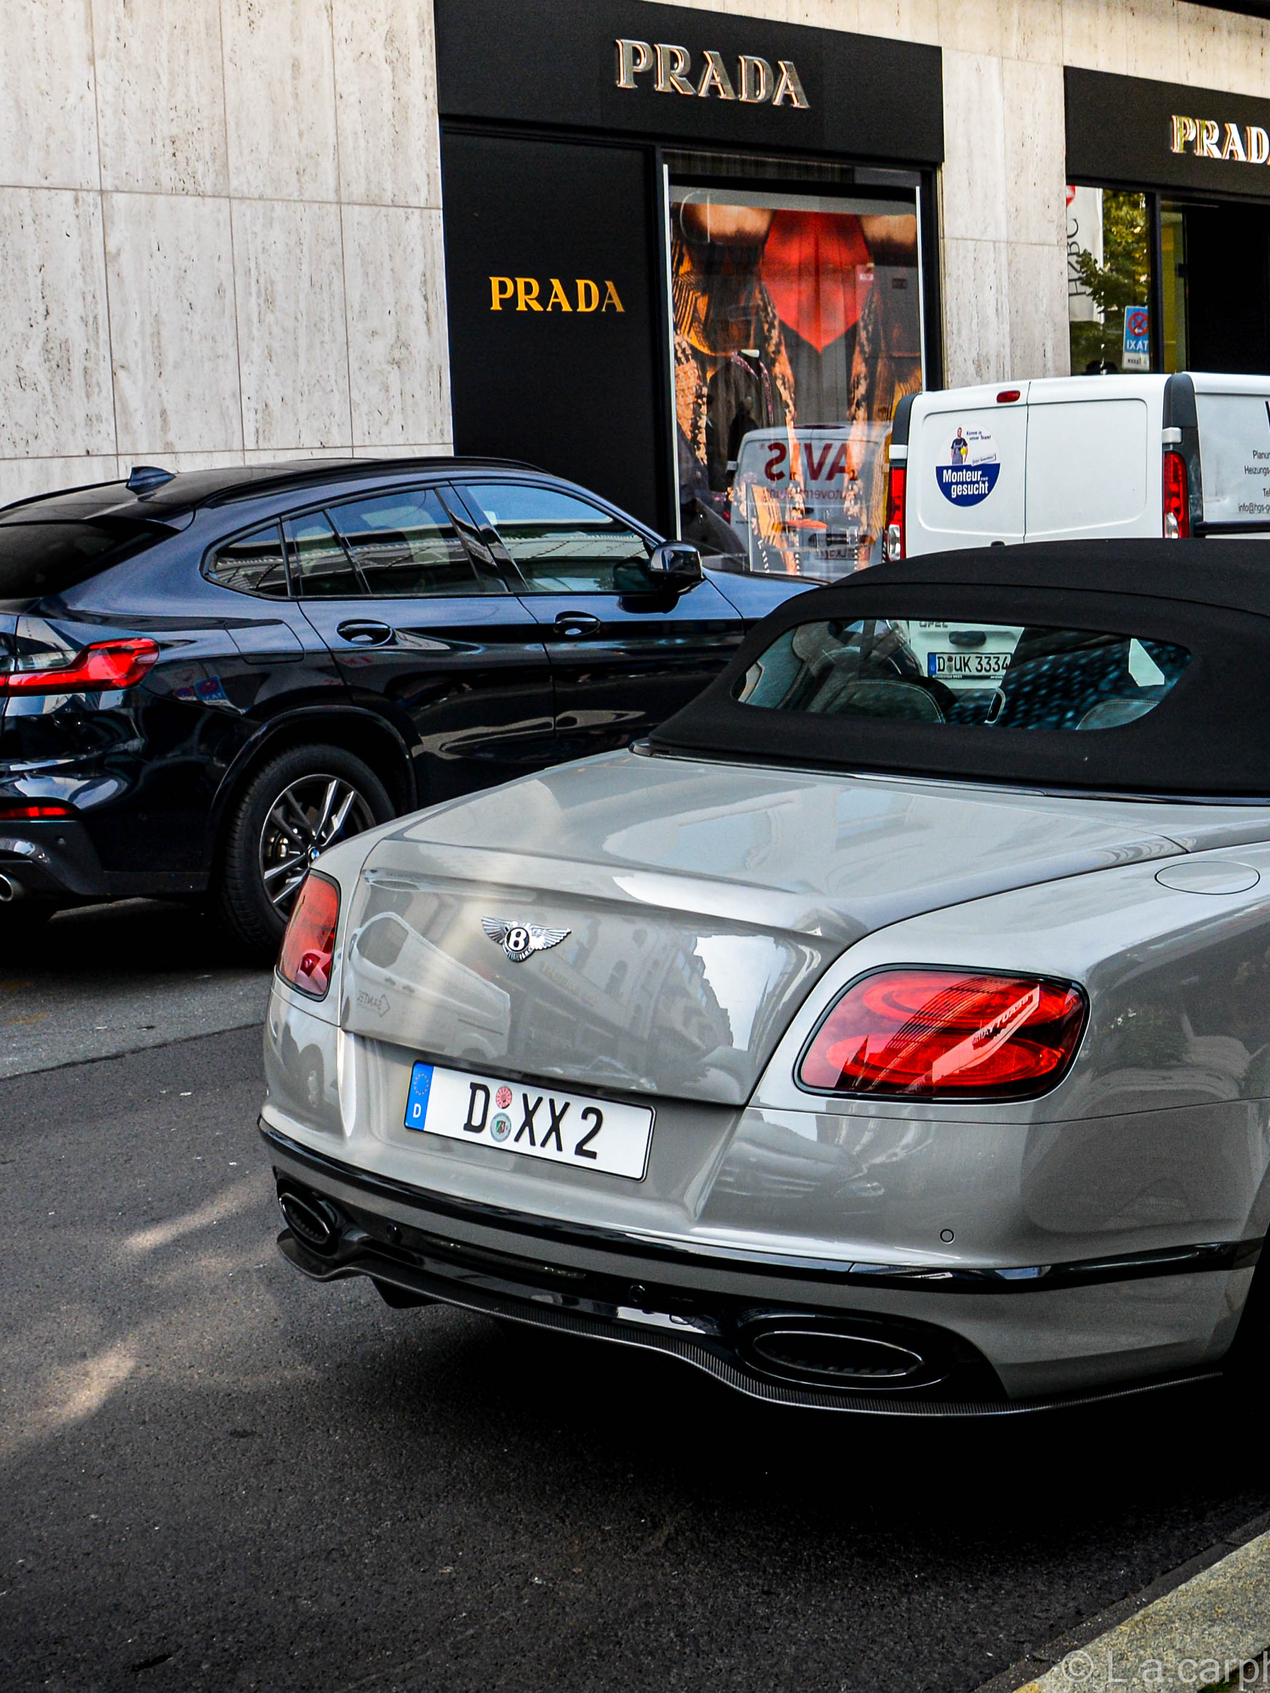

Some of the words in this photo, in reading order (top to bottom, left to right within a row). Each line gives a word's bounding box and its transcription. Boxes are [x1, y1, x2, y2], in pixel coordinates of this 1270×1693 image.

[615, 39, 810, 109] PRADA
[489, 276, 625, 312] PRADA
[943, 469, 982, 482] Monteur
[951, 481, 988, 498] gesucht
[937, 656, 945, 672] D
[954, 656, 972, 672] UK
[975, 656, 1008, 672] 3334
[509, 927, 528, 951] B
[412, 1103, 422, 1118] D
[463, 1082, 490, 1133] D
[513, 1093, 571, 1152] XX
[574, 1106, 604, 1160] 2
